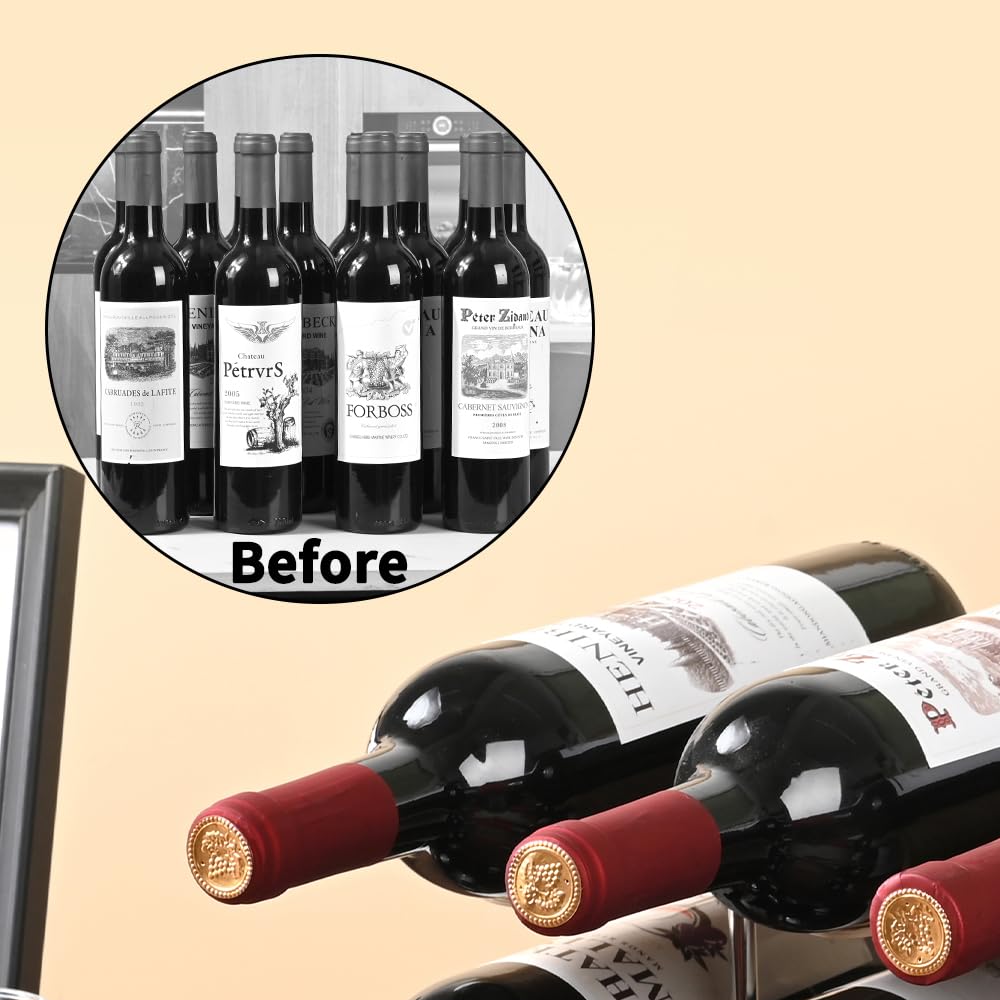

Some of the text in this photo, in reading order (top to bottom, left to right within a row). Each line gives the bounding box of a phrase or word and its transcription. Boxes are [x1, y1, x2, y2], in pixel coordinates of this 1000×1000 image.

[498, 308, 529, 323] Zidan
[237, 352, 265, 360] Chateau
[346, 403, 413, 419] FORBOSS
